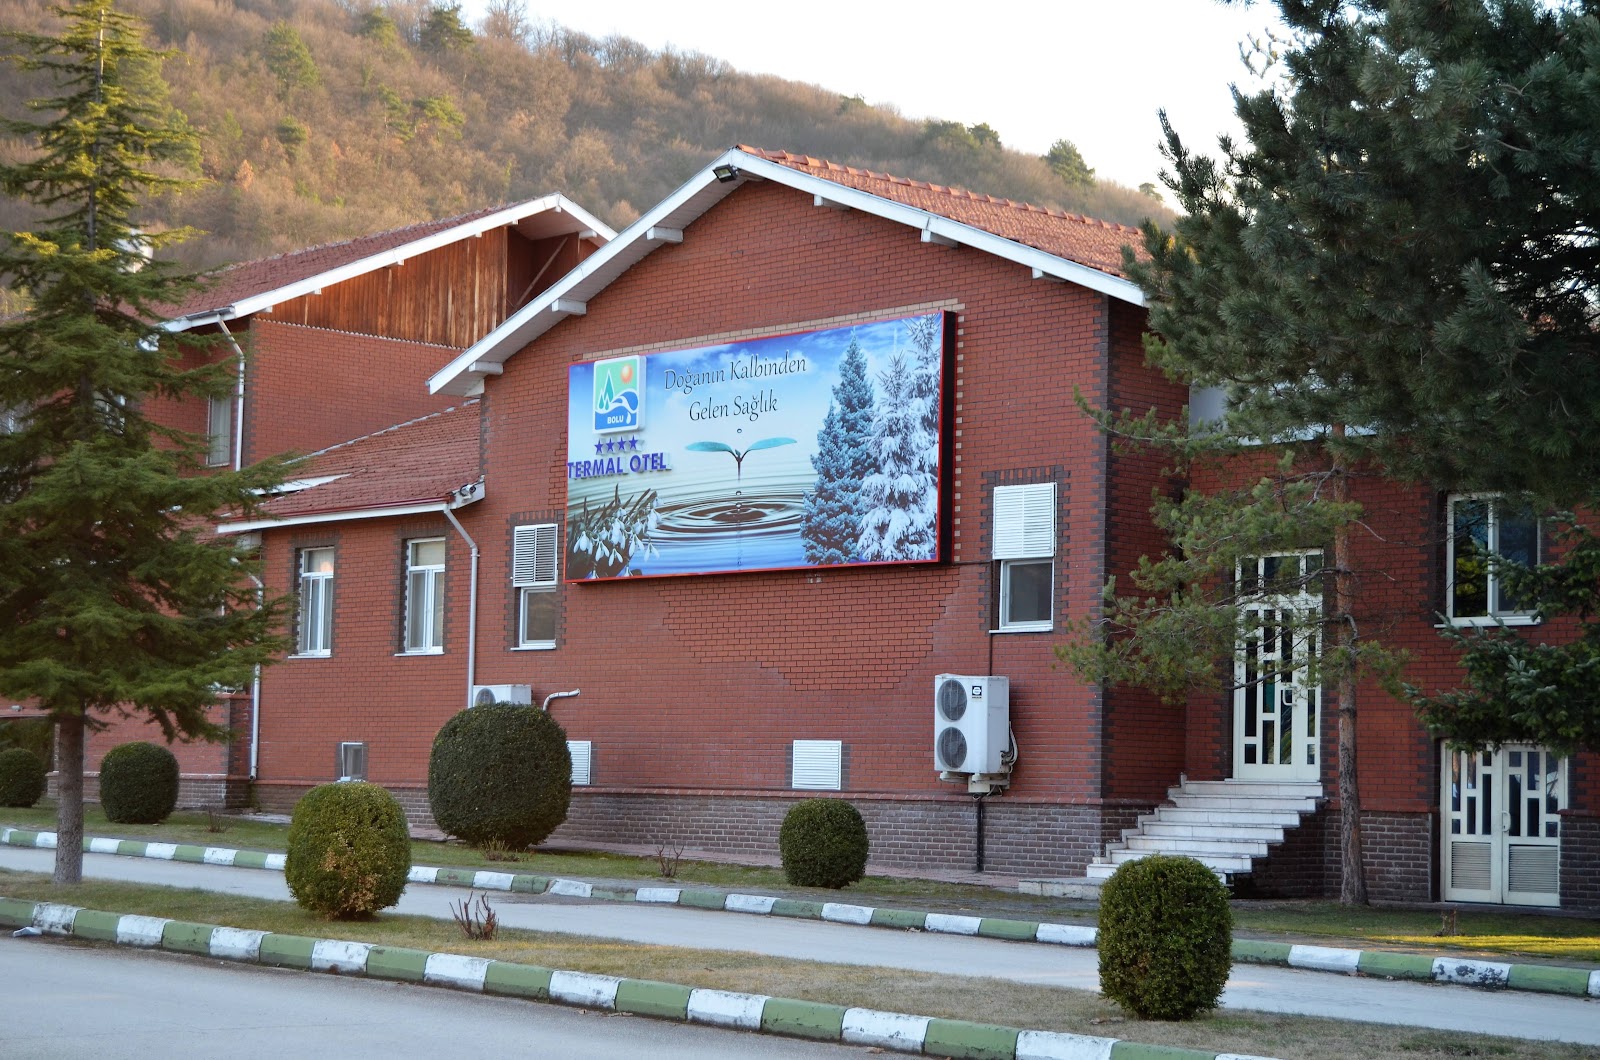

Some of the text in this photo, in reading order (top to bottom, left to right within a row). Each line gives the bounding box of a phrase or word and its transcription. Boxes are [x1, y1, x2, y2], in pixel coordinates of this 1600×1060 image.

[664, 350, 807, 395] Doğanın Kalbinden
[607, 415, 624, 424] BOLU
[689, 389, 778, 422] Gelen Sağlık
[567, 452, 667, 479] TERMAL OTEL
